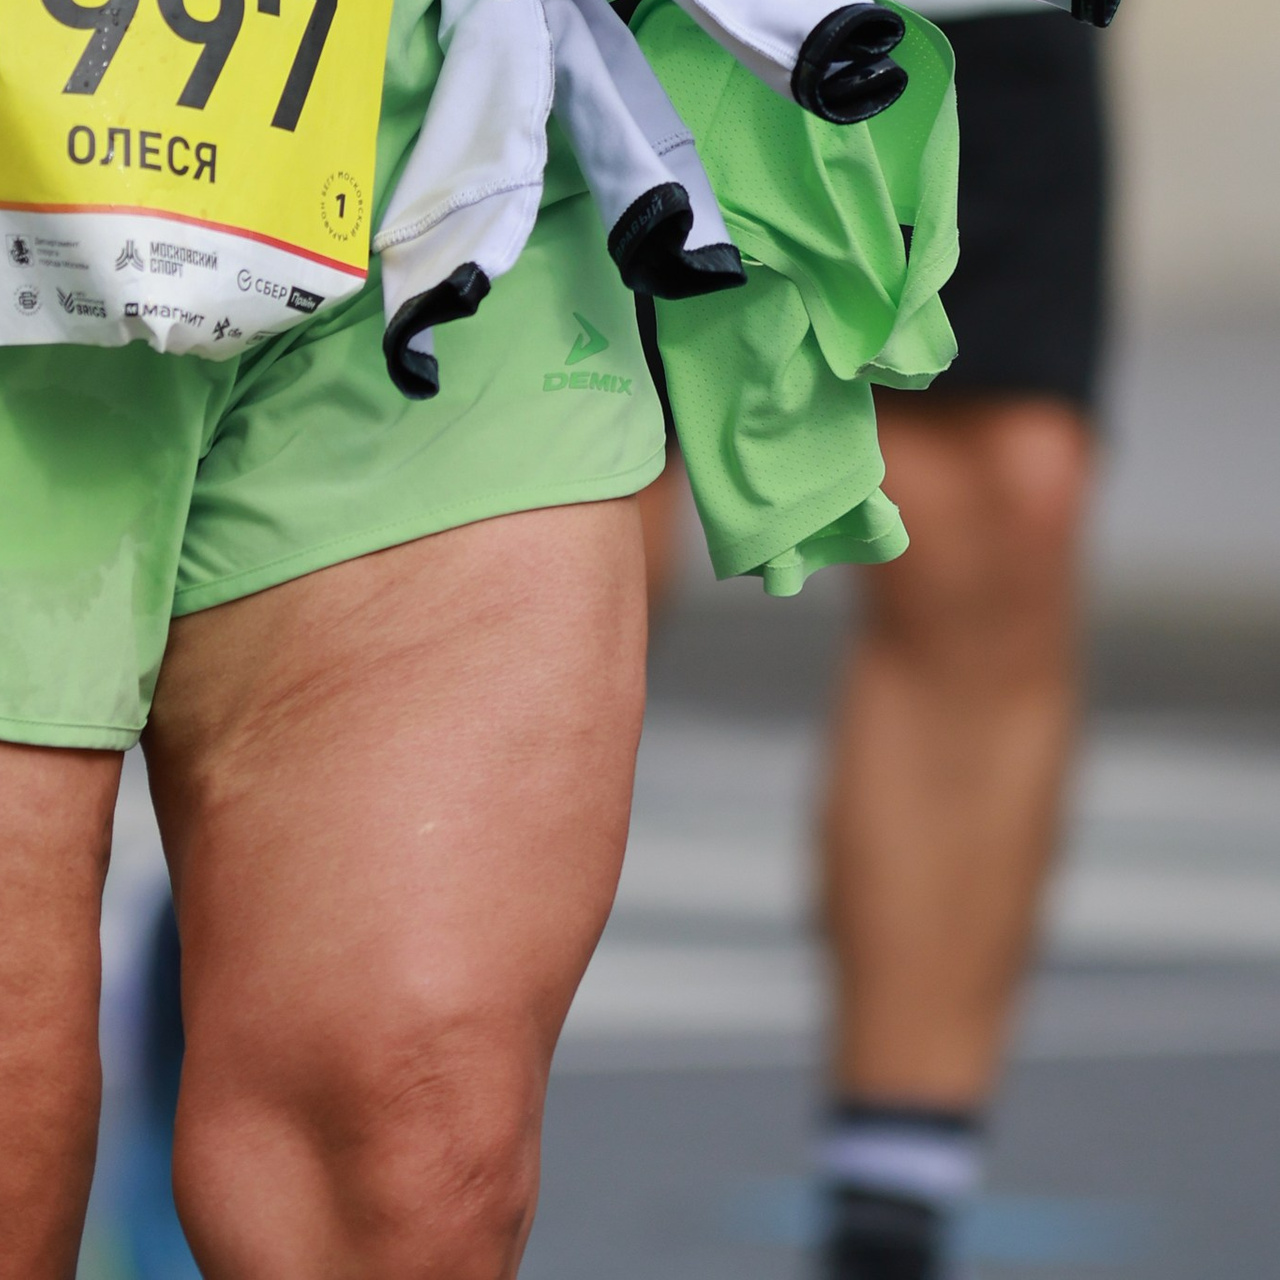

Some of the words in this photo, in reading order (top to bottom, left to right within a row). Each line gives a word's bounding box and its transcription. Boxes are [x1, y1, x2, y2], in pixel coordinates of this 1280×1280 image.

[66, 124, 218, 184] ОЛЕСЯ
[335, 192, 346, 219] 1
[150, 241, 218, 271] МОСКОВСКИЙ
[150, 260, 184, 278] СПОРТ
[255, 278, 288, 300] СБЕР
[76, 304, 107, 319] BRICS
[542, 371, 633, 396] DEMIX
